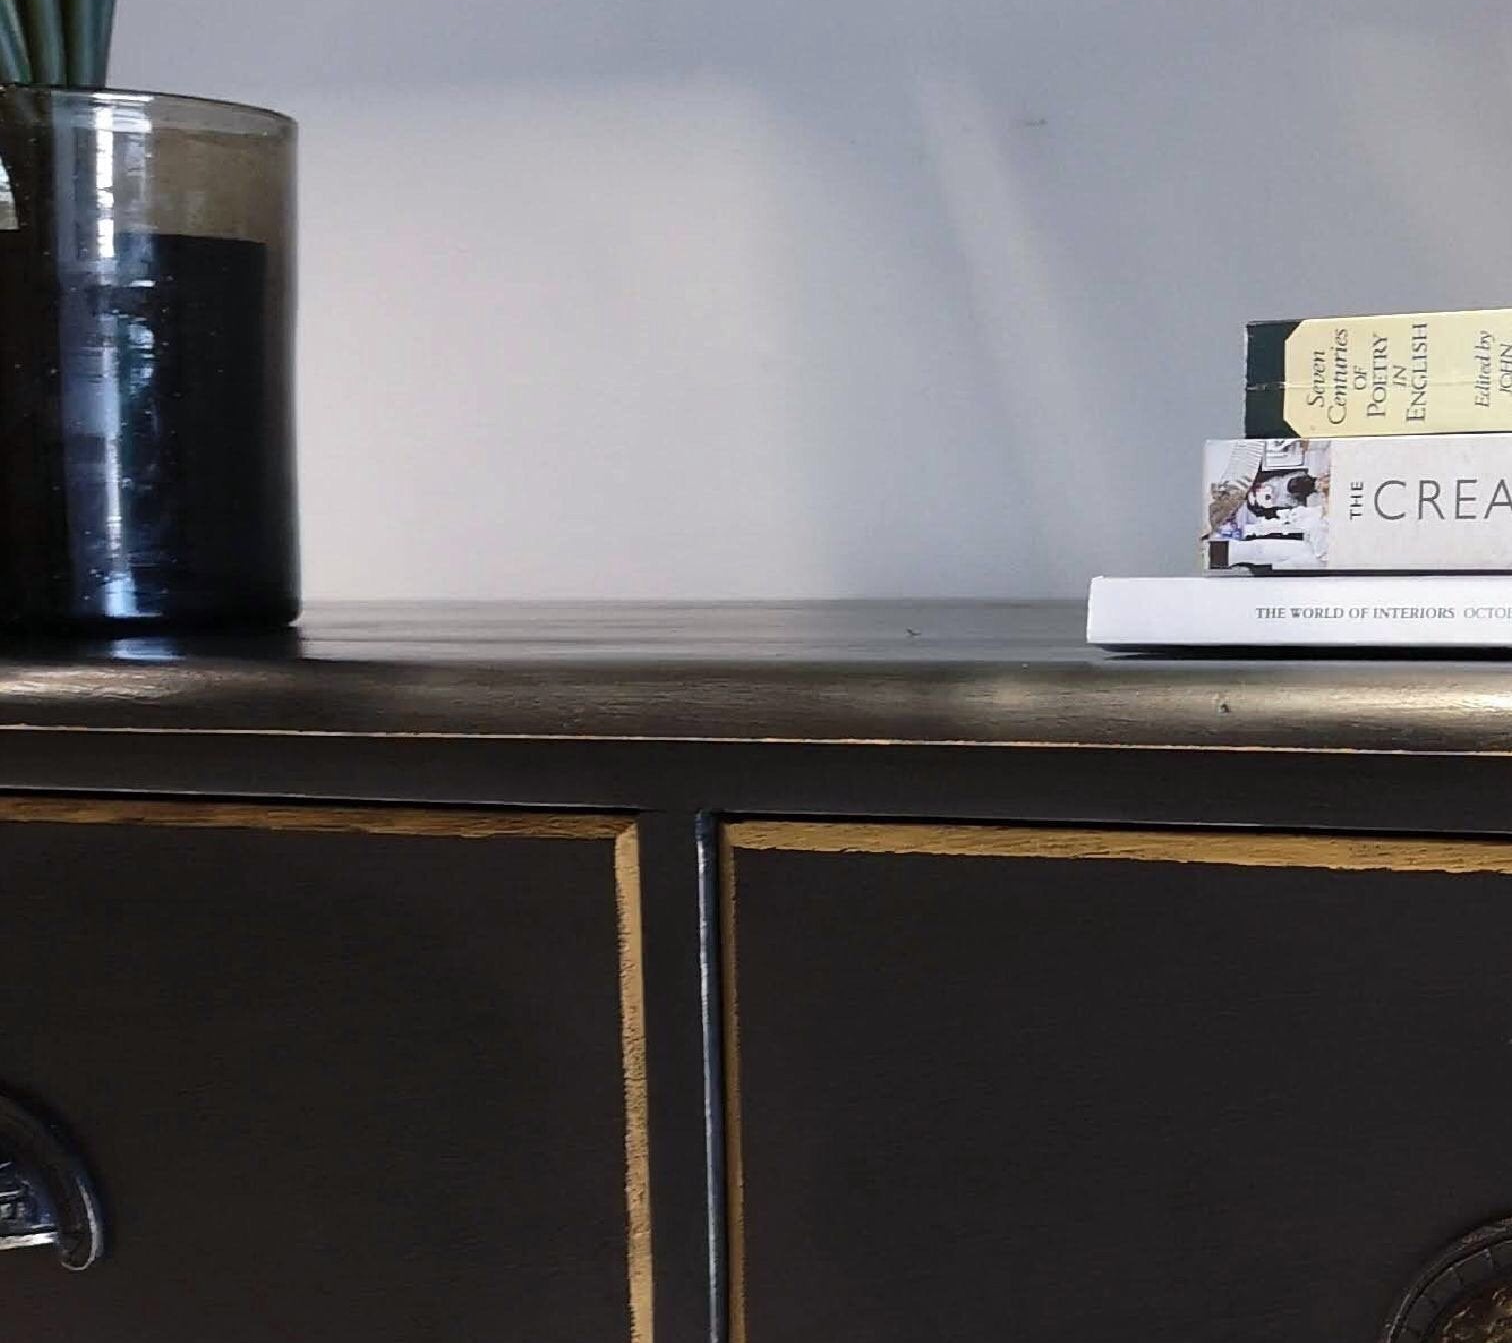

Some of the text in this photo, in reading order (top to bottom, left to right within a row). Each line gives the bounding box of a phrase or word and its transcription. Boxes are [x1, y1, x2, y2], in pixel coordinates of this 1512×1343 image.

[1307, 350, 1326, 408] Seven
[1327, 328, 1349, 425] Centuries
[1353, 365, 1368, 391] OF
[1367, 333, 1388, 417] POETRY
[1393, 365, 1407, 388] IN
[1406, 323, 1428, 422] ENGLISH
[1475, 330, 1495, 407] Edited by
[1350, 480, 1364, 520] THE
[1255, 607, 1286, 619] THE
[1290, 607, 1344, 619] WORLD
[1349, 607, 1370, 619] OF
[1373, 607, 1455, 619] INTERIORS
